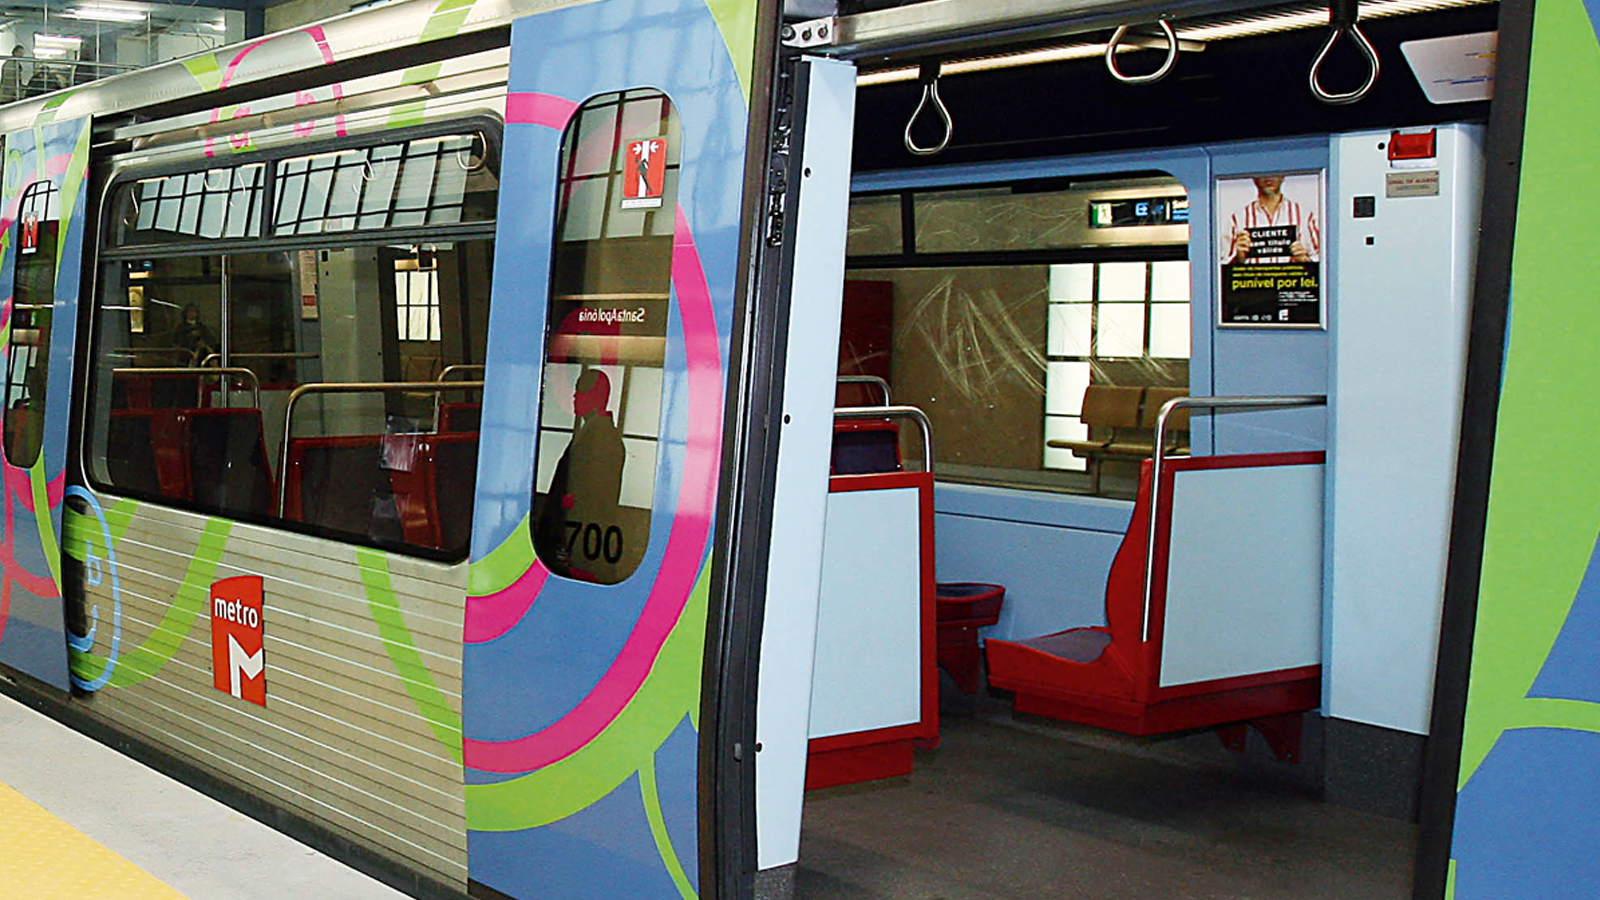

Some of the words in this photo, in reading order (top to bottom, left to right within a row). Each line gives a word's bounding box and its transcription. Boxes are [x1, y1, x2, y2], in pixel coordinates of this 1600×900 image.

[1251, 229, 1288, 238] CLIENTE
[1232, 277, 1274, 291] punível
[1277, 279, 1298, 290] por
[214, 597, 258, 629] metro
